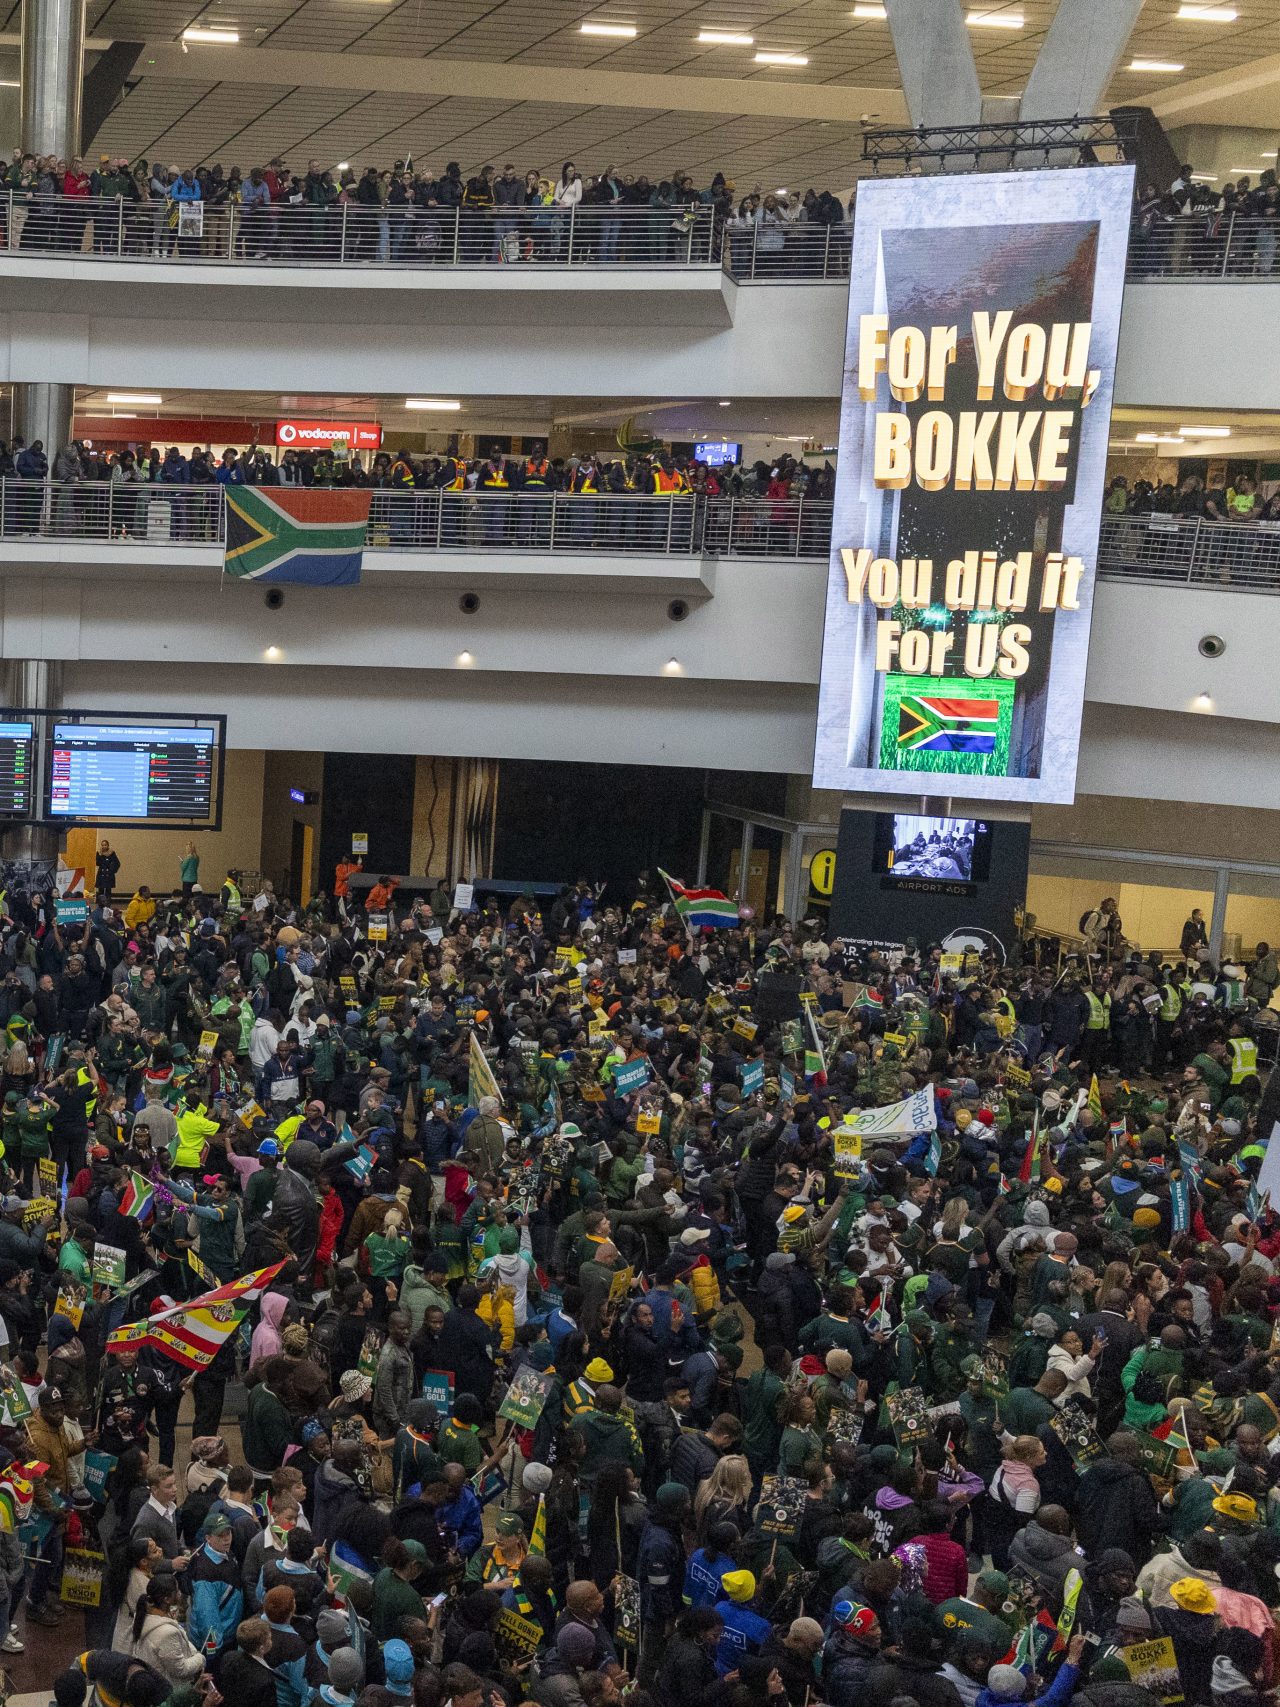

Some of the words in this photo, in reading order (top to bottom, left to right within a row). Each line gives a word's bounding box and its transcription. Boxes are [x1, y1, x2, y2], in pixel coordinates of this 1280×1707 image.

[858, 314, 958, 403] For
[971, 310, 1101, 409] You,
[297, 428, 351, 440] vodacom
[360, 432, 378, 440] Shop
[873, 410, 1075, 492] BOKKE
[841, 548, 933, 609] You
[945, 550, 1033, 613] did
[1039, 552, 1085, 613] it
[876, 620, 954, 676] For
[964, 623, 1032, 679] US
[897, 881, 942, 892] AIRPORT
[945, 886, 967, 895] ADS
[836, 937, 873, 946] Celebrating
[837, 1138, 858, 1147] BOKKE
[39, 1170, 57, 1182] BOKKE
[23, 1208, 56, 1223] BOKKE
[426, 1393, 447, 1402] GOLD
[432, 1387, 446, 1395] ARE
[68, 1588, 96, 1598] BOKKE
[1130, 1648, 1169, 1664] BOKKE
